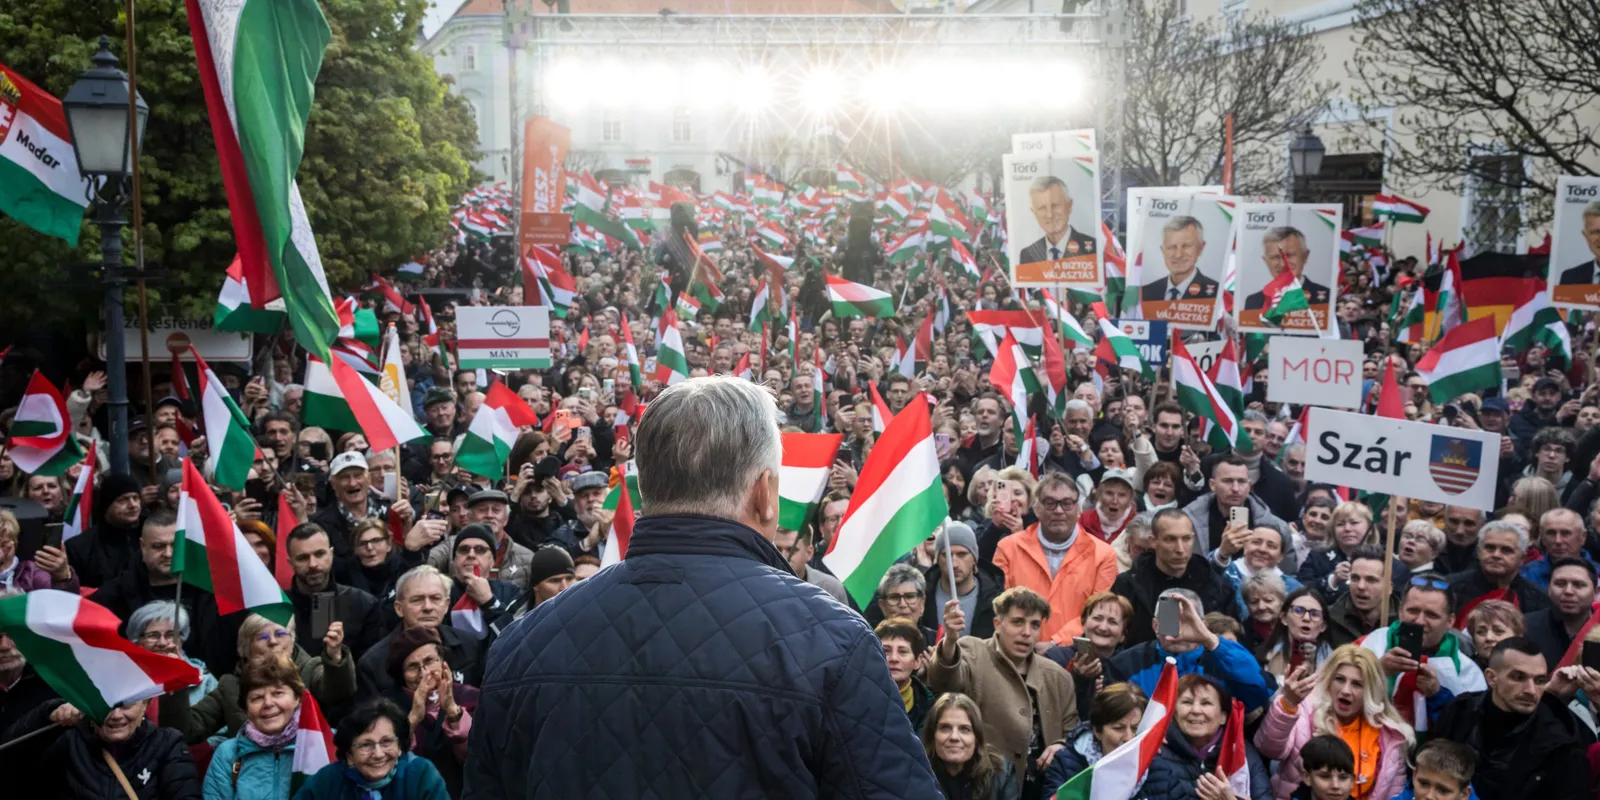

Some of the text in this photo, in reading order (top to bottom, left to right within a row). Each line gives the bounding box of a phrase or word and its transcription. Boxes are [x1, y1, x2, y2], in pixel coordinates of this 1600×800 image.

[16, 129, 61, 169] Madar
[1012, 162, 1038, 173] Törő
[1566, 185, 1597, 197] Törő
[1151, 198, 1179, 211] Törő
[1246, 212, 1276, 223] Törő
[1054, 261, 1094, 270] A BIZTOS
[1042, 270, 1095, 280] VÁLASZTÁS
[1178, 303, 1211, 313] BIZTOS
[1156, 309, 1209, 323] VÁLASZTÁS
[489, 349, 520, 358] MÁNY
[1282, 347, 1355, 385] MÓR
[1316, 430, 1412, 477] Szár
